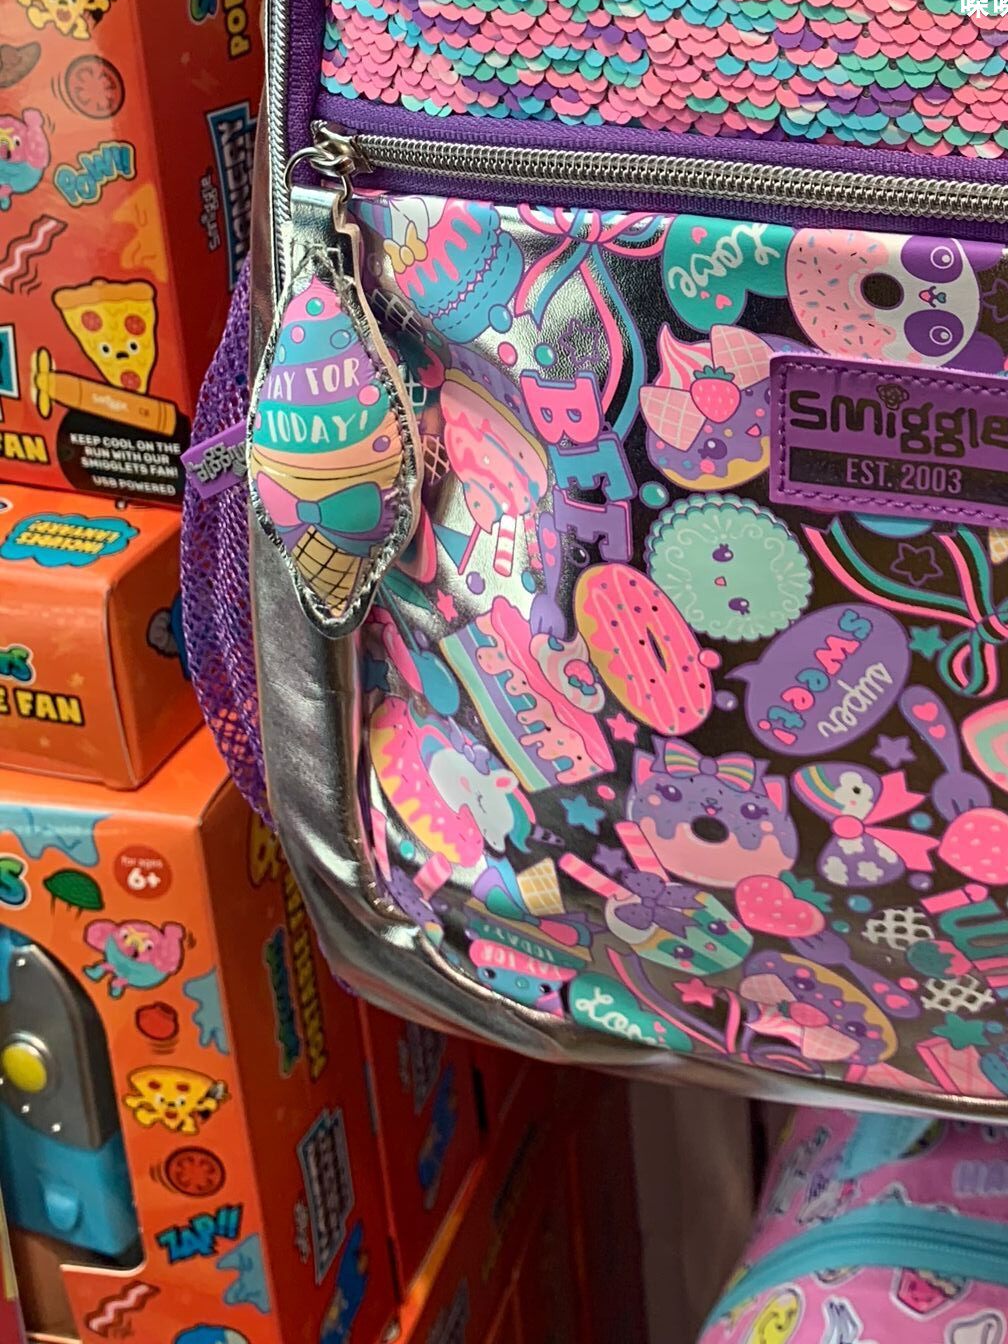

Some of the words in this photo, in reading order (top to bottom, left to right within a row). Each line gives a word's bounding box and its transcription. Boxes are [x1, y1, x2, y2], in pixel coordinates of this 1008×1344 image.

[304, 357, 361, 396] FOR
[265, 408, 369, 445] TODAY!
[69, 432, 101, 447] KEEP
[102, 436, 135, 452] COOL
[136, 439, 155, 453] ON
[156, 441, 182, 456] THE
[85, 445, 111, 458] RUN
[111, 448, 142, 462] WITH
[143, 452, 170, 465] OUR
[92, 474, 118, 489] USB
[119, 478, 177, 497] POWERED
[845, 460, 890, 488] EST.
[900, 464, 964, 495] 2003
[14, 688, 84, 726] FAN
[127, 866, 162, 891] 6+
